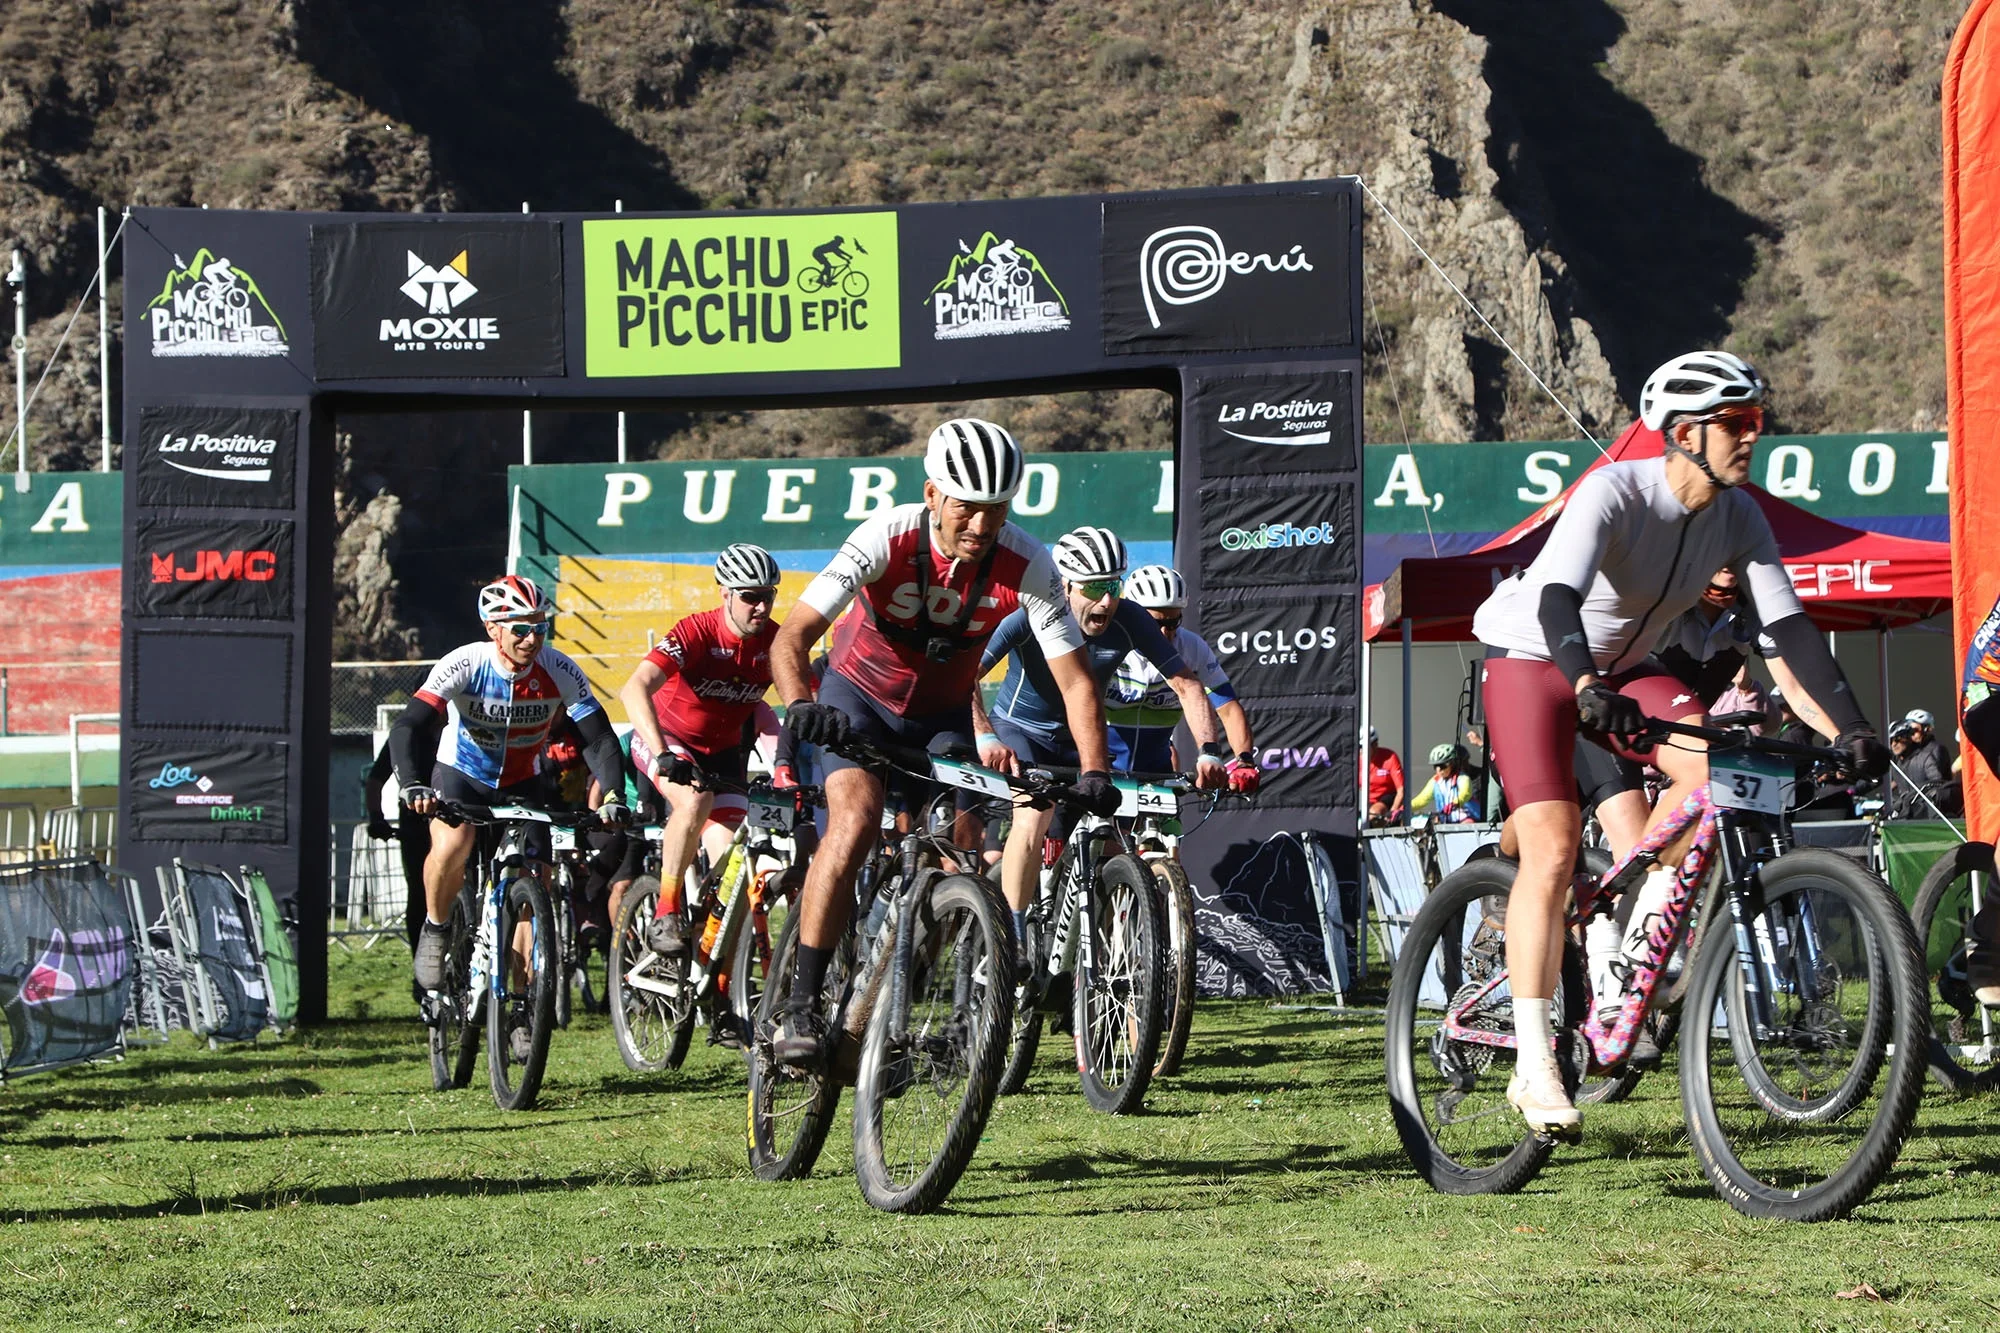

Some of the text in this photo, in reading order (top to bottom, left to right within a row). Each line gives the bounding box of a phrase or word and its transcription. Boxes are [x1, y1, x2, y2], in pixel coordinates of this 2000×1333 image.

[615, 235, 791, 292] MACHU
[1140, 225, 1314, 329] Perú
[957, 272, 1035, 307] MACHU
[173, 289, 253, 327] MACHU
[379, 317, 500, 341] MOXIE
[394, 341, 486, 351] MTB TOURS
[1218, 399, 1333, 423] La Positiva
[1282, 419, 1328, 432] Seguros
[158, 433, 277, 454] La Positiva
[221, 454, 269, 467] Seguros
[597, 462, 1058, 527] PUEBO
[1219, 521, 1335, 551] OxiShot
[175, 550, 276, 581] JMC
[151, 575, 172, 583] JMC
[1784, 559, 1893, 597] EPIC
[1217, 626, 1337, 654] CICLOS
[1258, 651, 1298, 665] CAFÉ
[469, 700, 550, 718] LA CARRERA
[1261, 746, 1332, 770] CIVA
[149, 762, 198, 788] Loa
[959, 770, 988, 789] 31
[1732, 773, 1763, 799] 37
[1138, 793, 1162, 807] 54
[760, 806, 783, 822] 24
